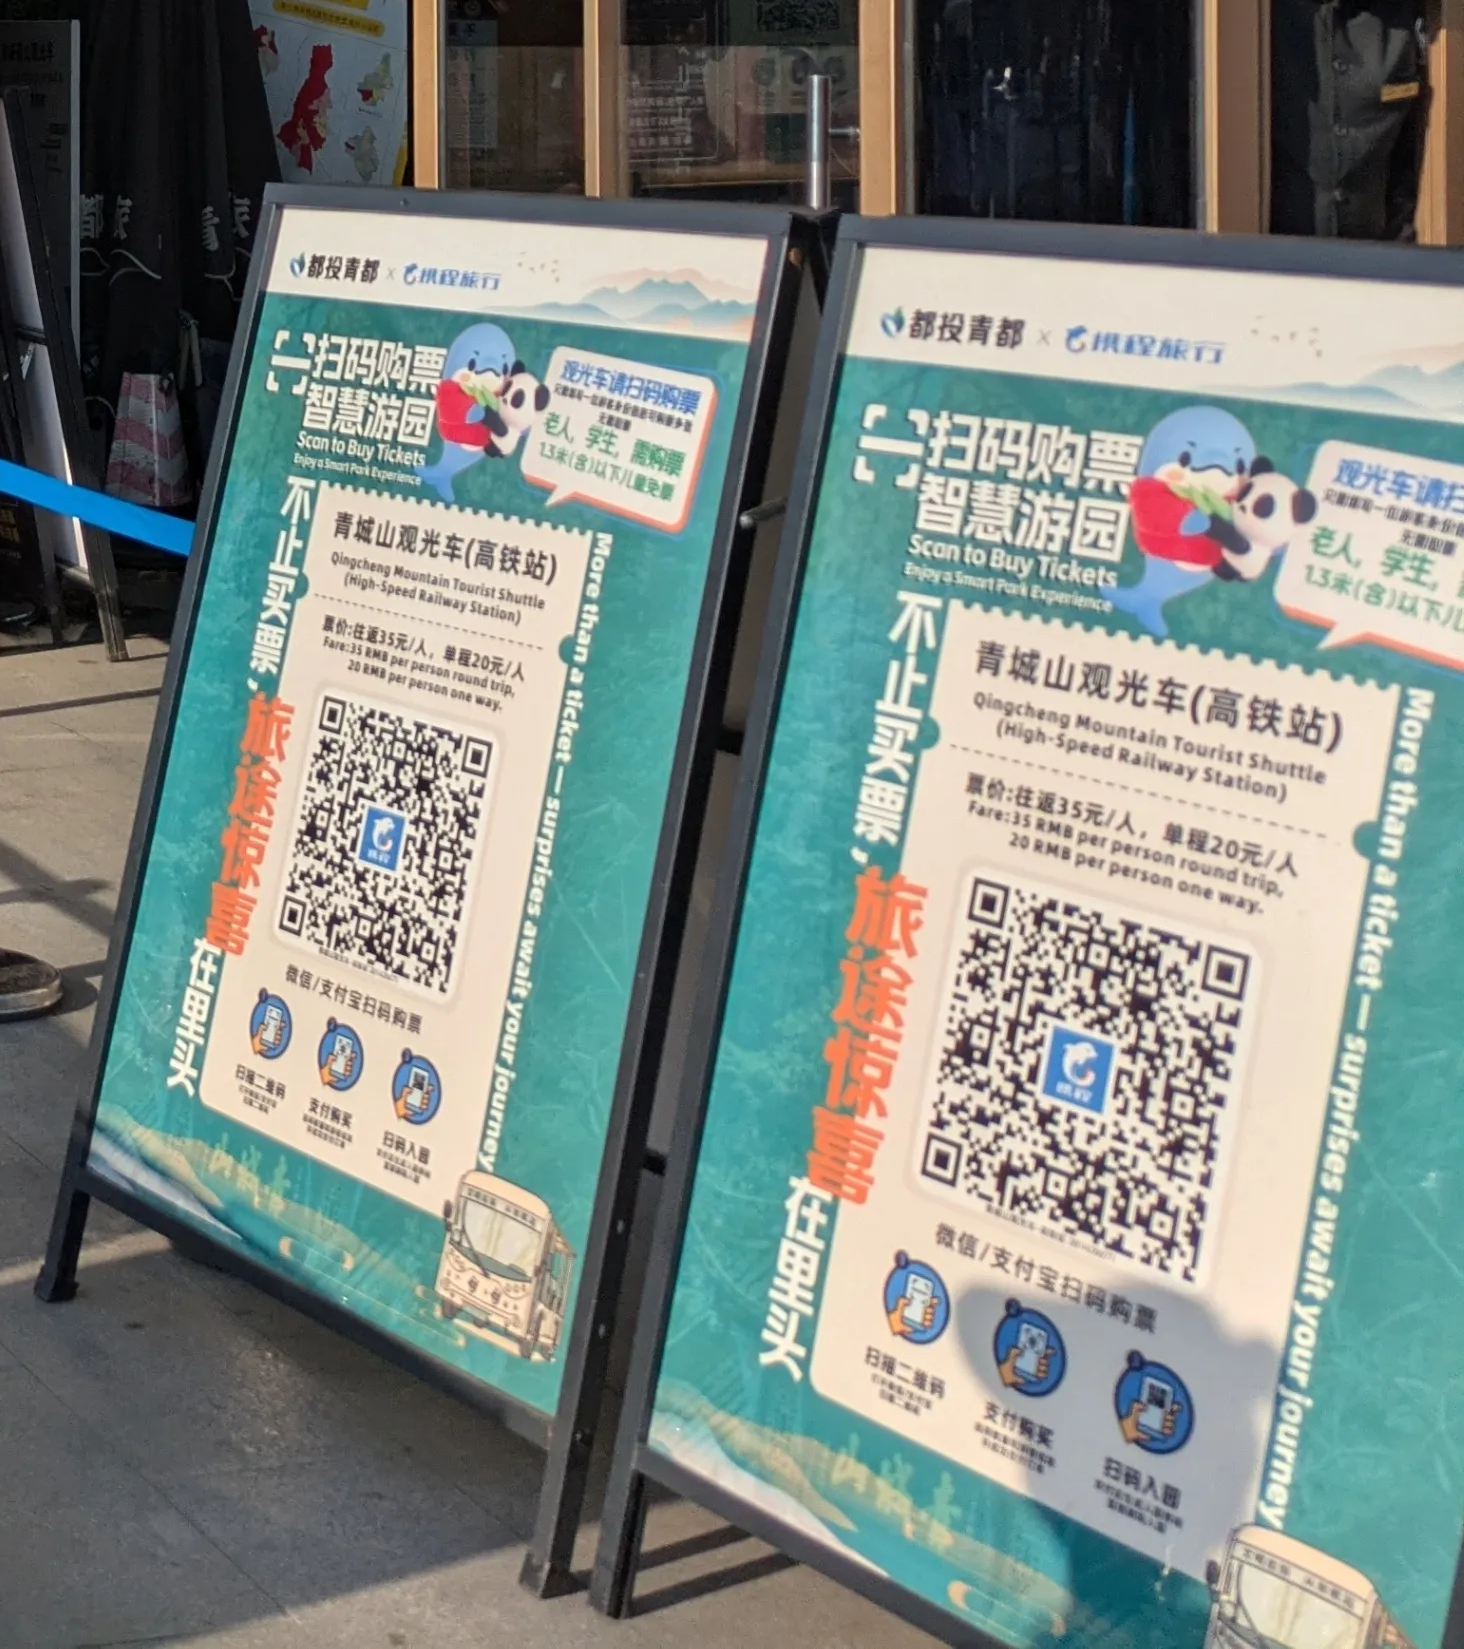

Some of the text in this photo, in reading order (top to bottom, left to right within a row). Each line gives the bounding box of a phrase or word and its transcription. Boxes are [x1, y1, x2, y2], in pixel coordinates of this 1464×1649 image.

[306, 253, 381, 284] 都投青都
[311, 334, 448, 395] 扫码购票
[911, 308, 1028, 349] 都投青都
[301, 382, 438, 447] 智慧游园
[927, 410, 1144, 496] 扫码购票
[332, 510, 559, 587] 青城山观光车(高铁站)
[910, 533, 1118, 590] Scan to Buy Tickets
[915, 472, 1131, 563] 智慧游园
[972, 690, 1327, 787] Qingcheng Mountain Tourist Shuttle
[973, 639, 1346, 756] 青城山观光车(高铁站)
[1391, 685, 1435, 778] More
[994, 718, 1288, 805] (High-Speed Railway Station)
[966, 798, 1286, 901] Fare:35 RMB per person round trip,
[1376, 778, 1418, 864] than
[1353, 890, 1400, 994] ticket
[284, 963, 422, 1037] 微信/支付宝扫码购票
[1313, 1029, 1375, 1196] surprises
[934, 1220, 1159, 1337] 微信/支付宝扫码购票
[1299, 1192, 1347, 1302] await
[1279, 1292, 1326, 1388] your
[1254, 1378, 1316, 1532] journey
